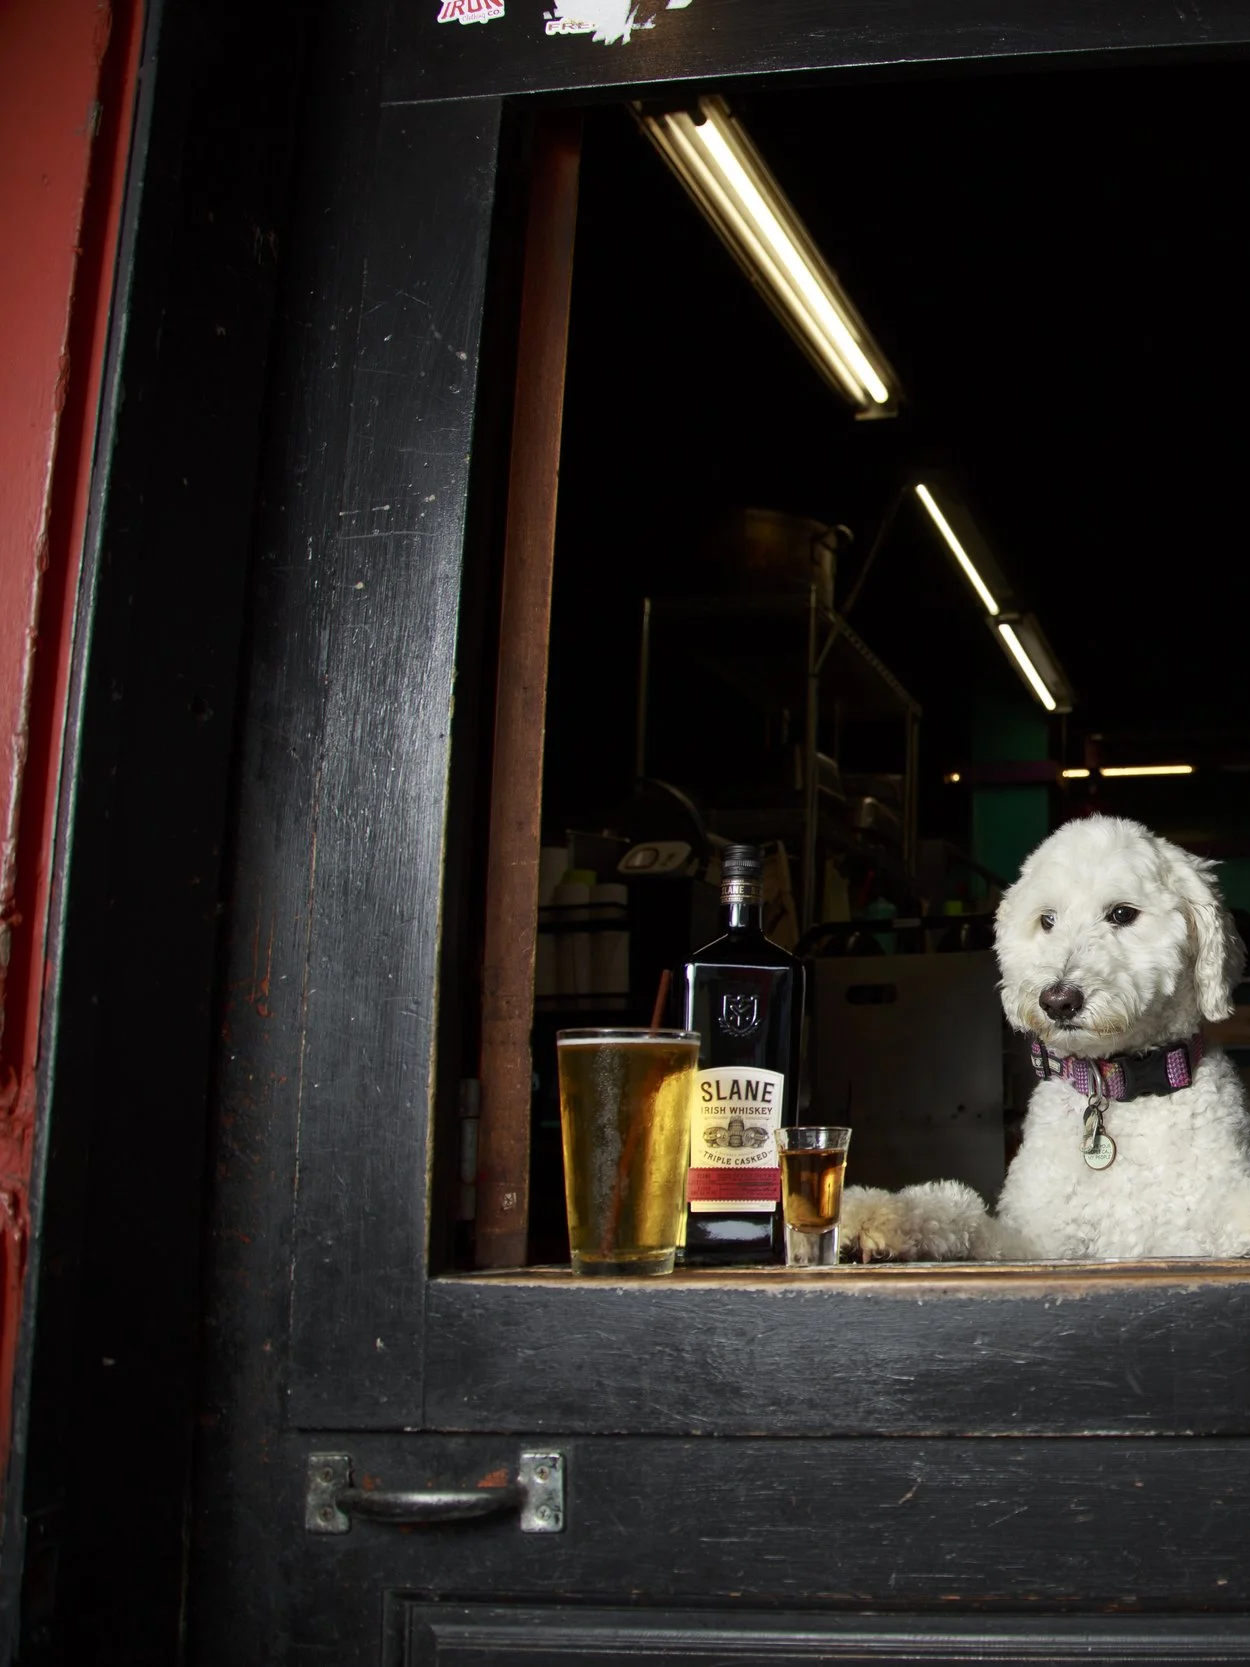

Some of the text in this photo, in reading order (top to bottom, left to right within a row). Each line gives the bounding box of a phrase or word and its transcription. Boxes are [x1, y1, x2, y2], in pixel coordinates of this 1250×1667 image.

[700, 1079, 775, 1103] SLANE
[700, 1106, 773, 1115] IRISH WHISKEY
[703, 1150, 732, 1165] TRIPLE
[734, 1150, 768, 1165] CASKED
